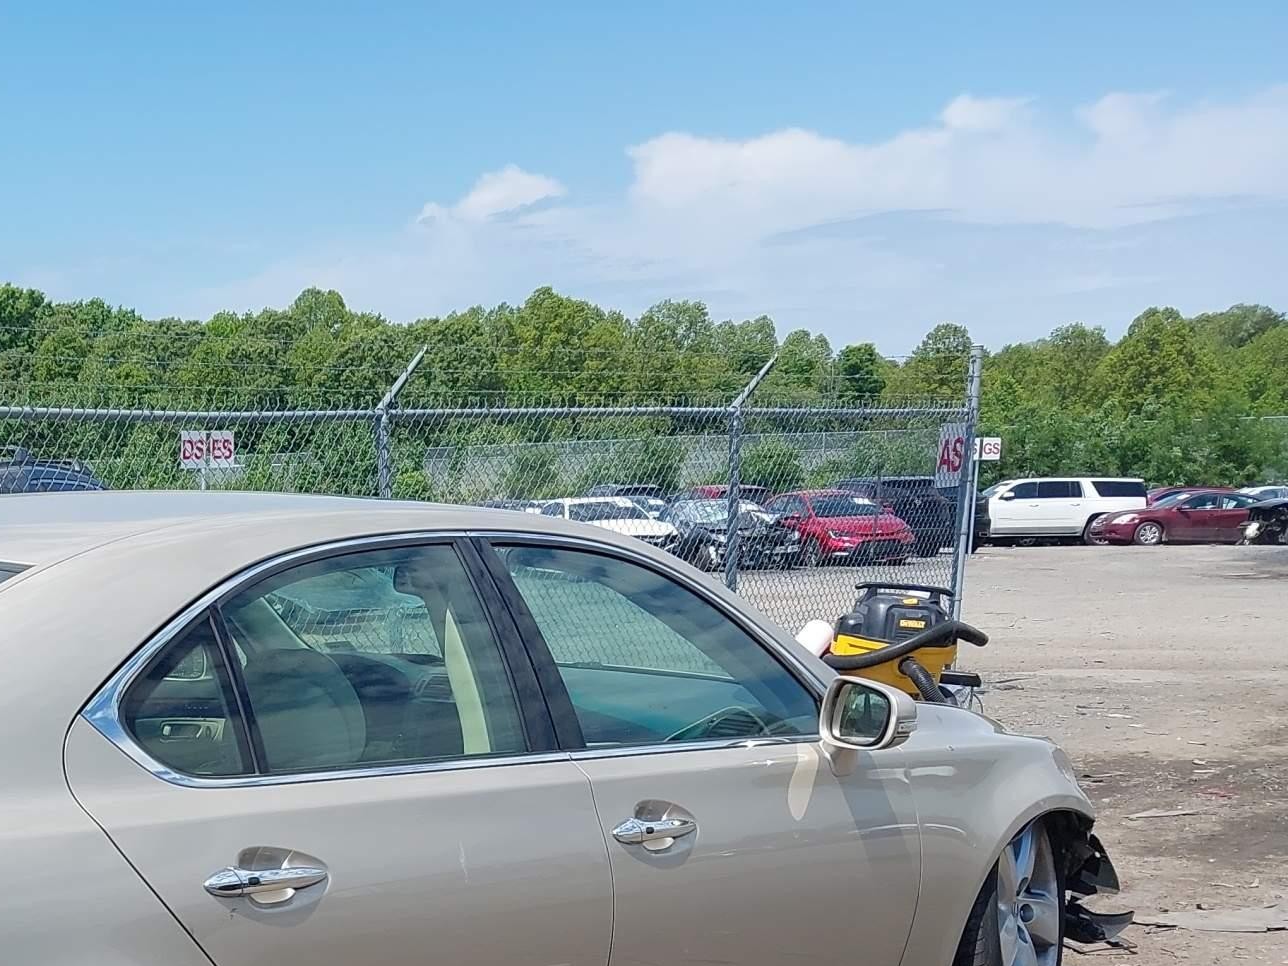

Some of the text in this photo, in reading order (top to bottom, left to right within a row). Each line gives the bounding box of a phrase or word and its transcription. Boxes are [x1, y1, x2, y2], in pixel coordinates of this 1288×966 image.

[183, 439, 204, 460] DS
[212, 439, 232, 459] ES
[937, 437, 964, 472] AS
[983, 442, 1000, 455] GS
